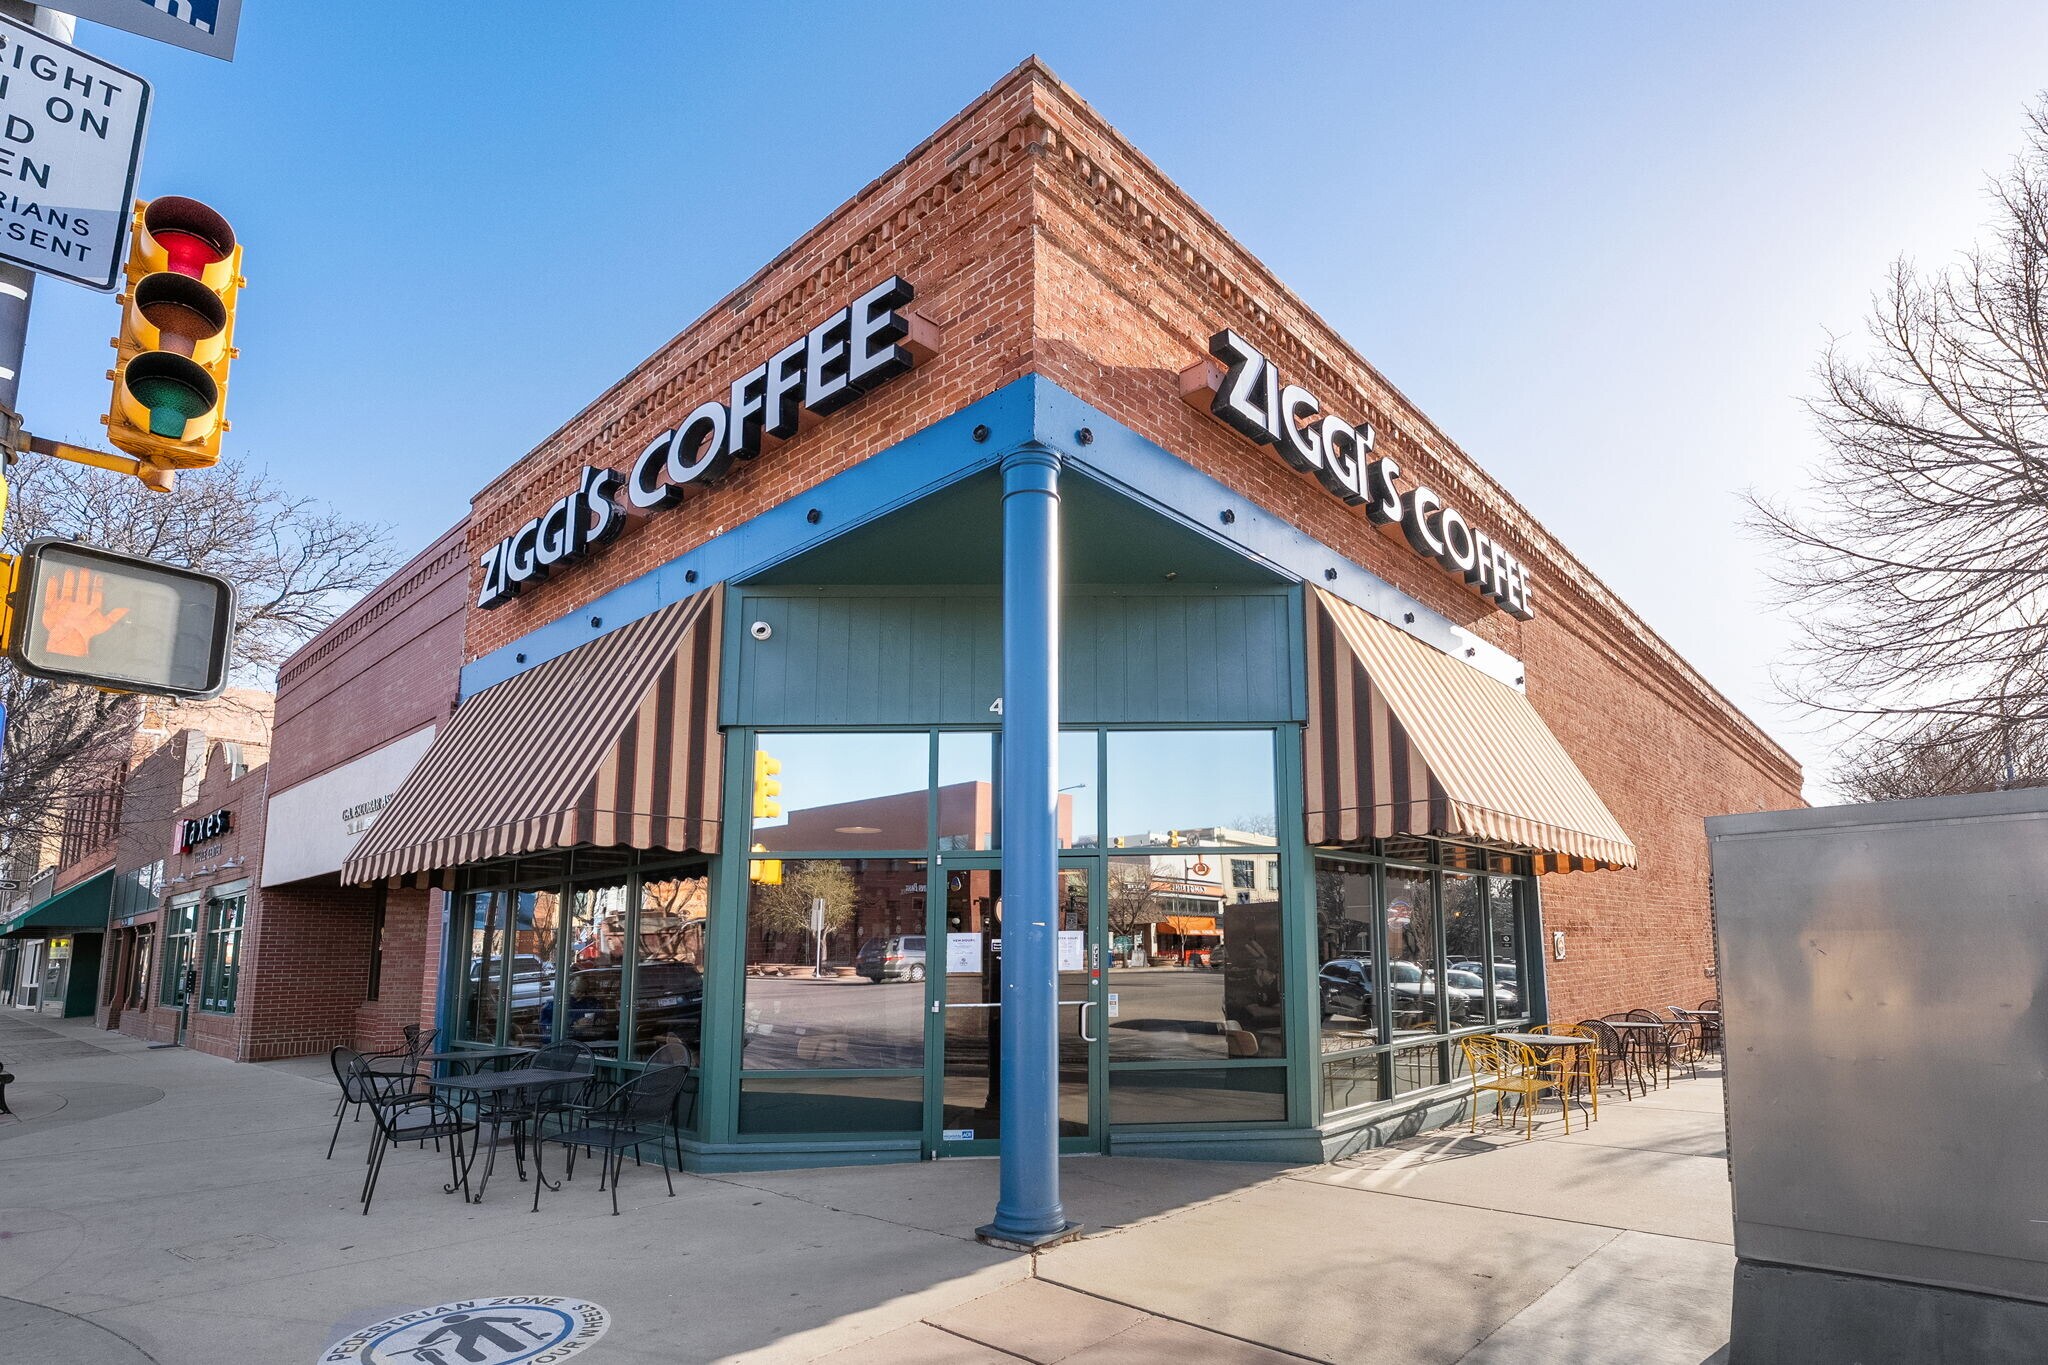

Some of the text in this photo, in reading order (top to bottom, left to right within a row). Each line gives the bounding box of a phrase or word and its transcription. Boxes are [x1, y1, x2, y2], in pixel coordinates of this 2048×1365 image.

[46, 97, 109, 140] ON
[477, 275, 910, 609] ZIGGI'S COFFEE
[1211, 328, 1534, 621] ZIGGI'S COFFEE
[989, 697, 1003, 716] 4
[182, 809, 223, 847] Taxes
[326, 1296, 565, 1362] PEDESTRIAN ZONE
[527, 1304, 604, 1365] OUR WHEELS
